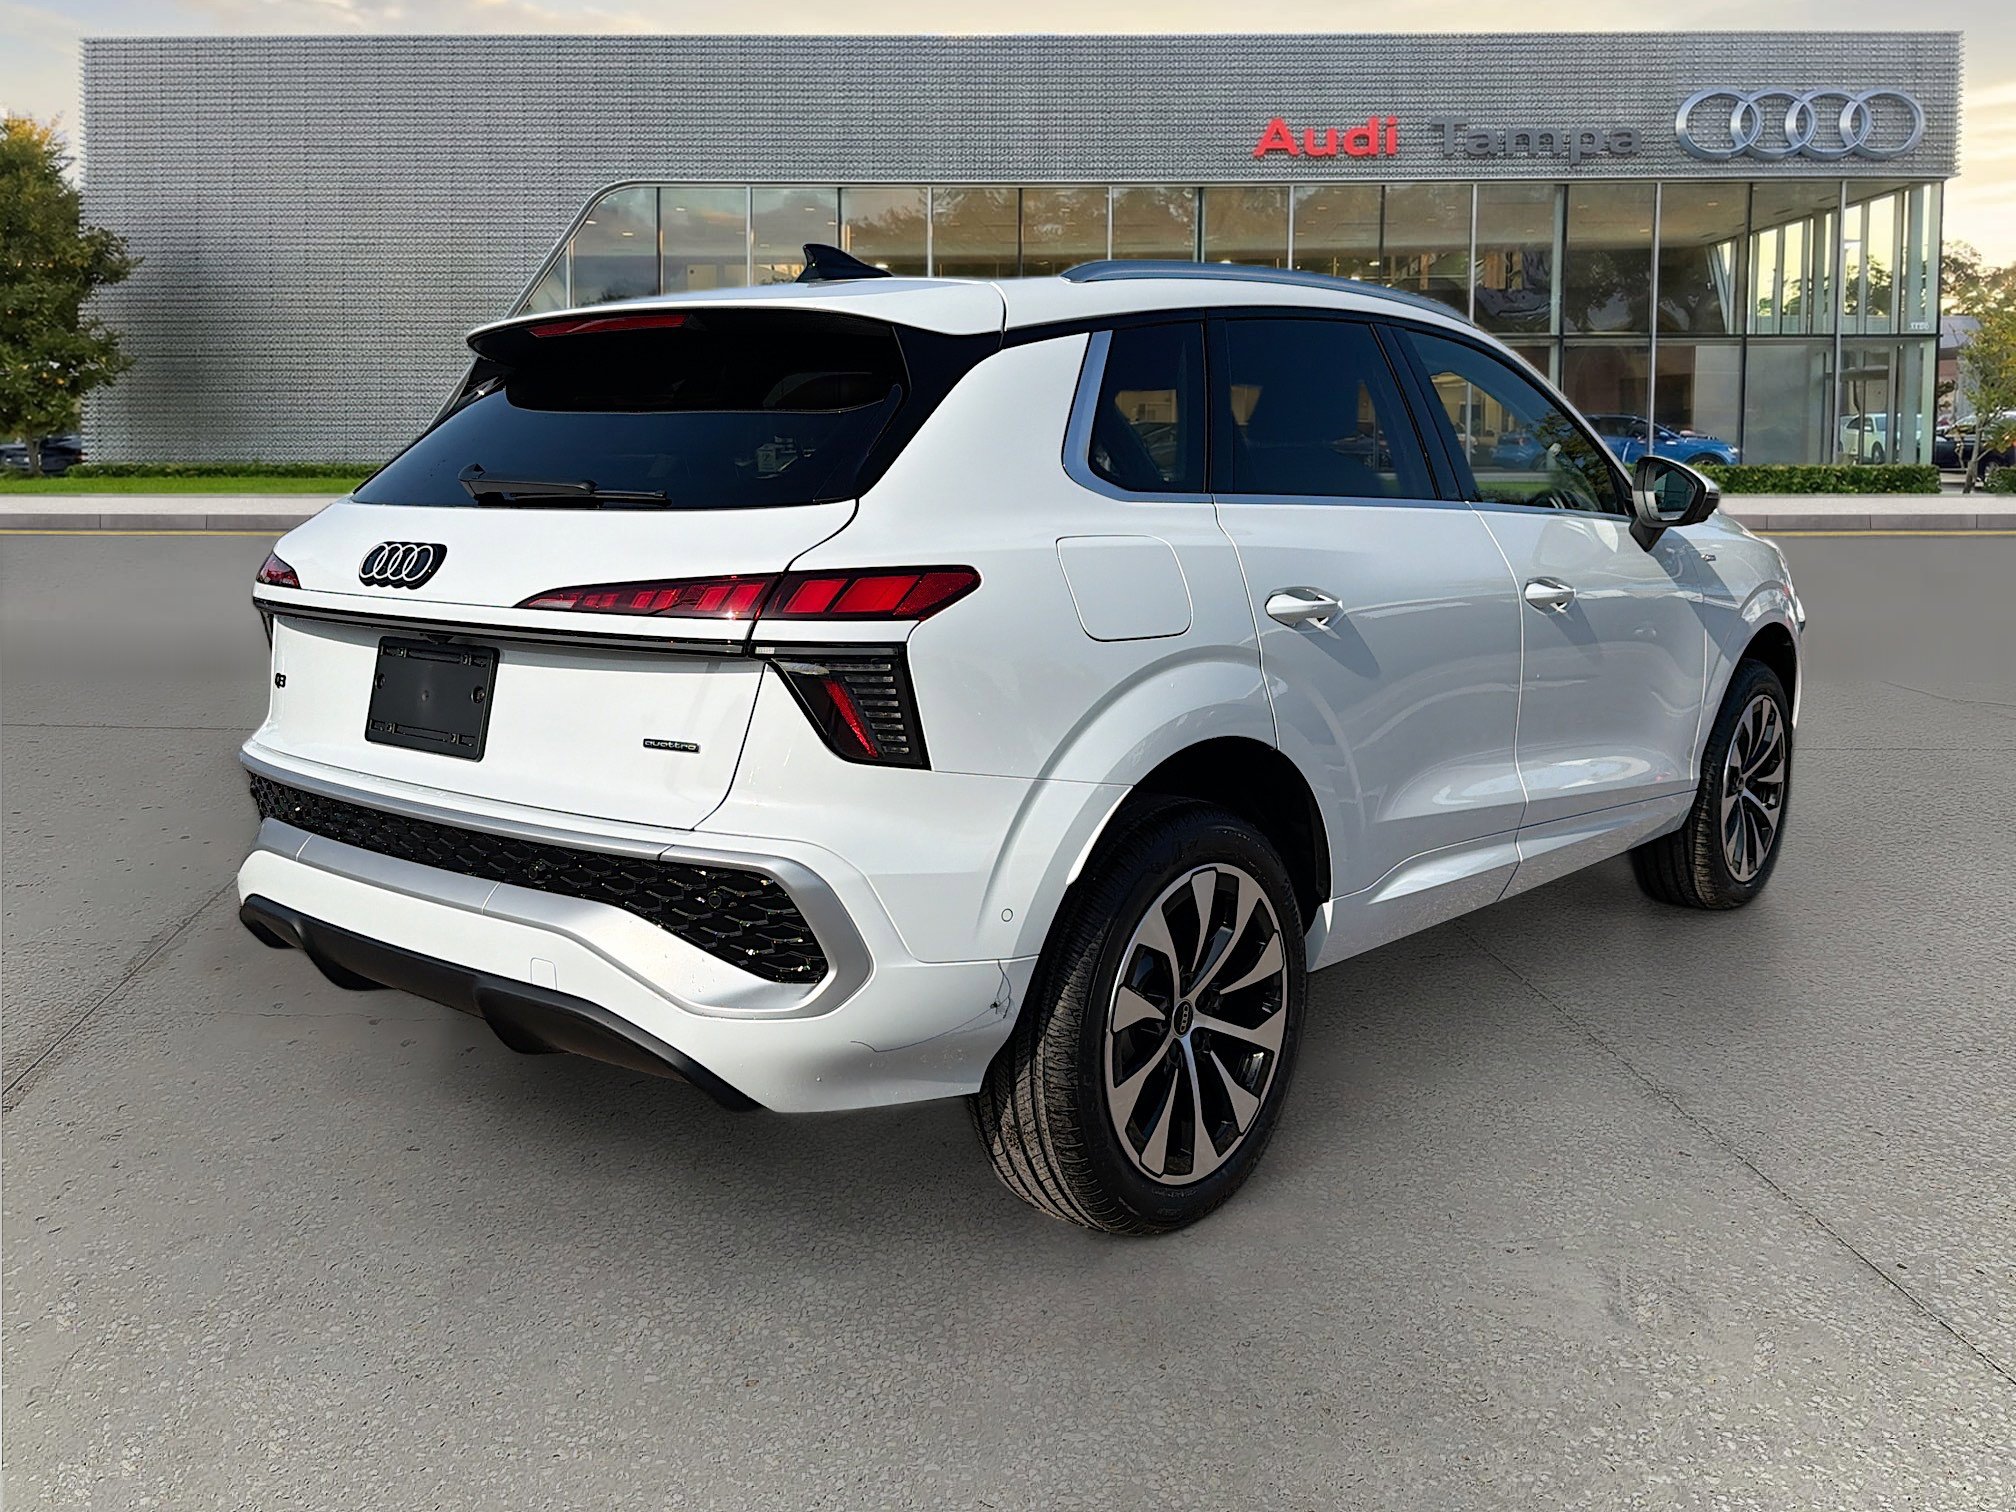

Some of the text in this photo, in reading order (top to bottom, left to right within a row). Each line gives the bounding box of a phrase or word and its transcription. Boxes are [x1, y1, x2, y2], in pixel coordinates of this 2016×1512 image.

[1254, 116, 1642, 165] Audi Tampa
[644, 740, 697, 751] quattro
